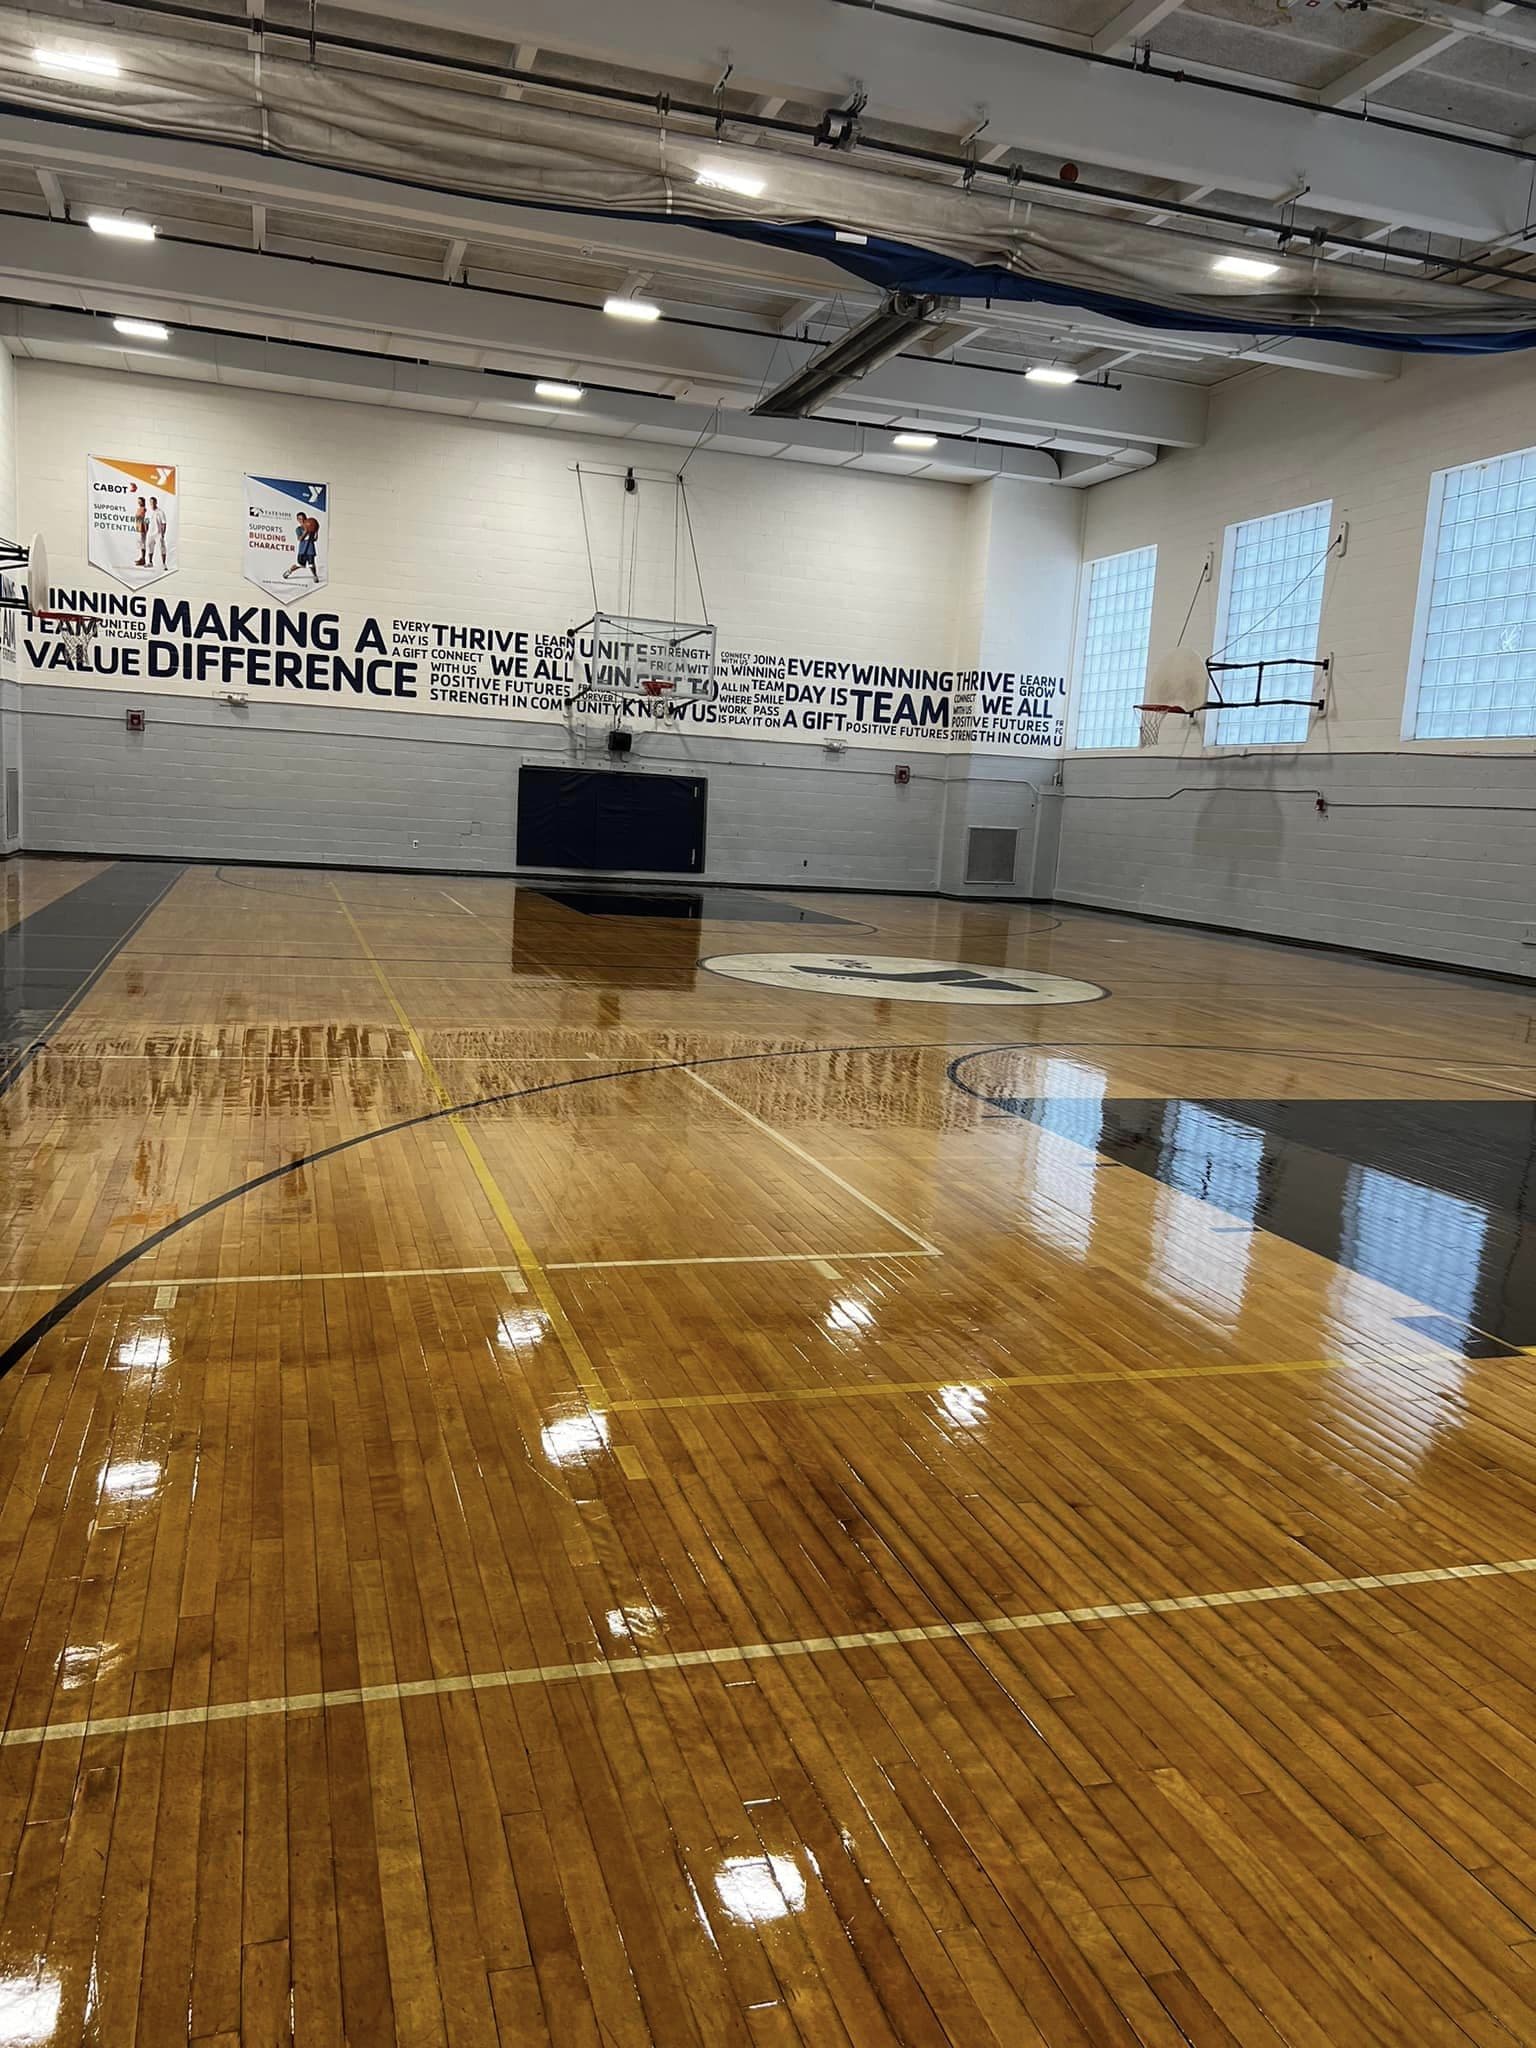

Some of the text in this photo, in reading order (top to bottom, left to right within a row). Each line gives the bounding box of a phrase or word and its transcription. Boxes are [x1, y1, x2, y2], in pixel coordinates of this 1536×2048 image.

[93, 483, 128, 494] CABOT
[93, 503, 126, 512] SUPPORTS
[249, 523, 282, 533] SUPPORTS
[249, 532, 286, 542] BUILDING
[249, 541, 295, 552] CHARACTER
[21, 611, 98, 637] TEAM
[100, 619, 146, 631] UNITED
[151, 598, 388, 655] MAKING A
[392, 620, 430, 633] EVERY
[105, 629, 148, 640] IN CAUSE
[392, 633, 429, 646] DAY IS
[432, 624, 528, 654] THRIVE
[23, 639, 140, 676] VALUE
[392, 647, 428, 659] A GIFT
[431, 648, 484, 663] CONNECT
[720, 651, 750, 660] CONNECT
[753, 655, 786, 666] JOIN A
[148, 640, 417, 698] DIFFERENCE
[431, 662, 477, 675] WITH US
[491, 655, 574, 682] WE ALL
[731, 665, 785, 679] WINNING
[788, 658, 851, 680] EVERY
[851, 664, 953, 692] WINNING
[956, 671, 1015, 693] THRIVE
[1020, 675, 1056, 687] LEARN
[430, 673, 500, 691] POSITIVE
[505, 680, 570, 697] FUTURES
[721, 682, 750, 693] ALL IN
[751, 679, 784, 692] TEAM
[430, 689, 508, 707] STRENGTH
[513, 696, 527, 708] IN
[578, 691, 614, 702] OREVER
[786, 683, 848, 706] DAY IS
[1019, 686, 1055, 698] GROW
[719, 694, 752, 705] WHERE
[754, 693, 784, 705] SMILE
[692, 703, 717, 723] US
[718, 704, 747, 715] WORK
[753, 705, 779, 716] PASS
[850, 688, 949, 728] TEAM
[982, 694, 1053, 719] WE ALL
[718, 715, 751, 725] IS PLAY
[752, 717, 781, 728] IT ON
[783, 709, 847, 731] A GIFT
[952, 716, 1049, 733] POSITIVE FUTURES
[846, 722, 949, 740] POSITIVE FUTURES
[950, 730, 995, 743] STRENGTH
[998, 732, 1010, 743] IN
